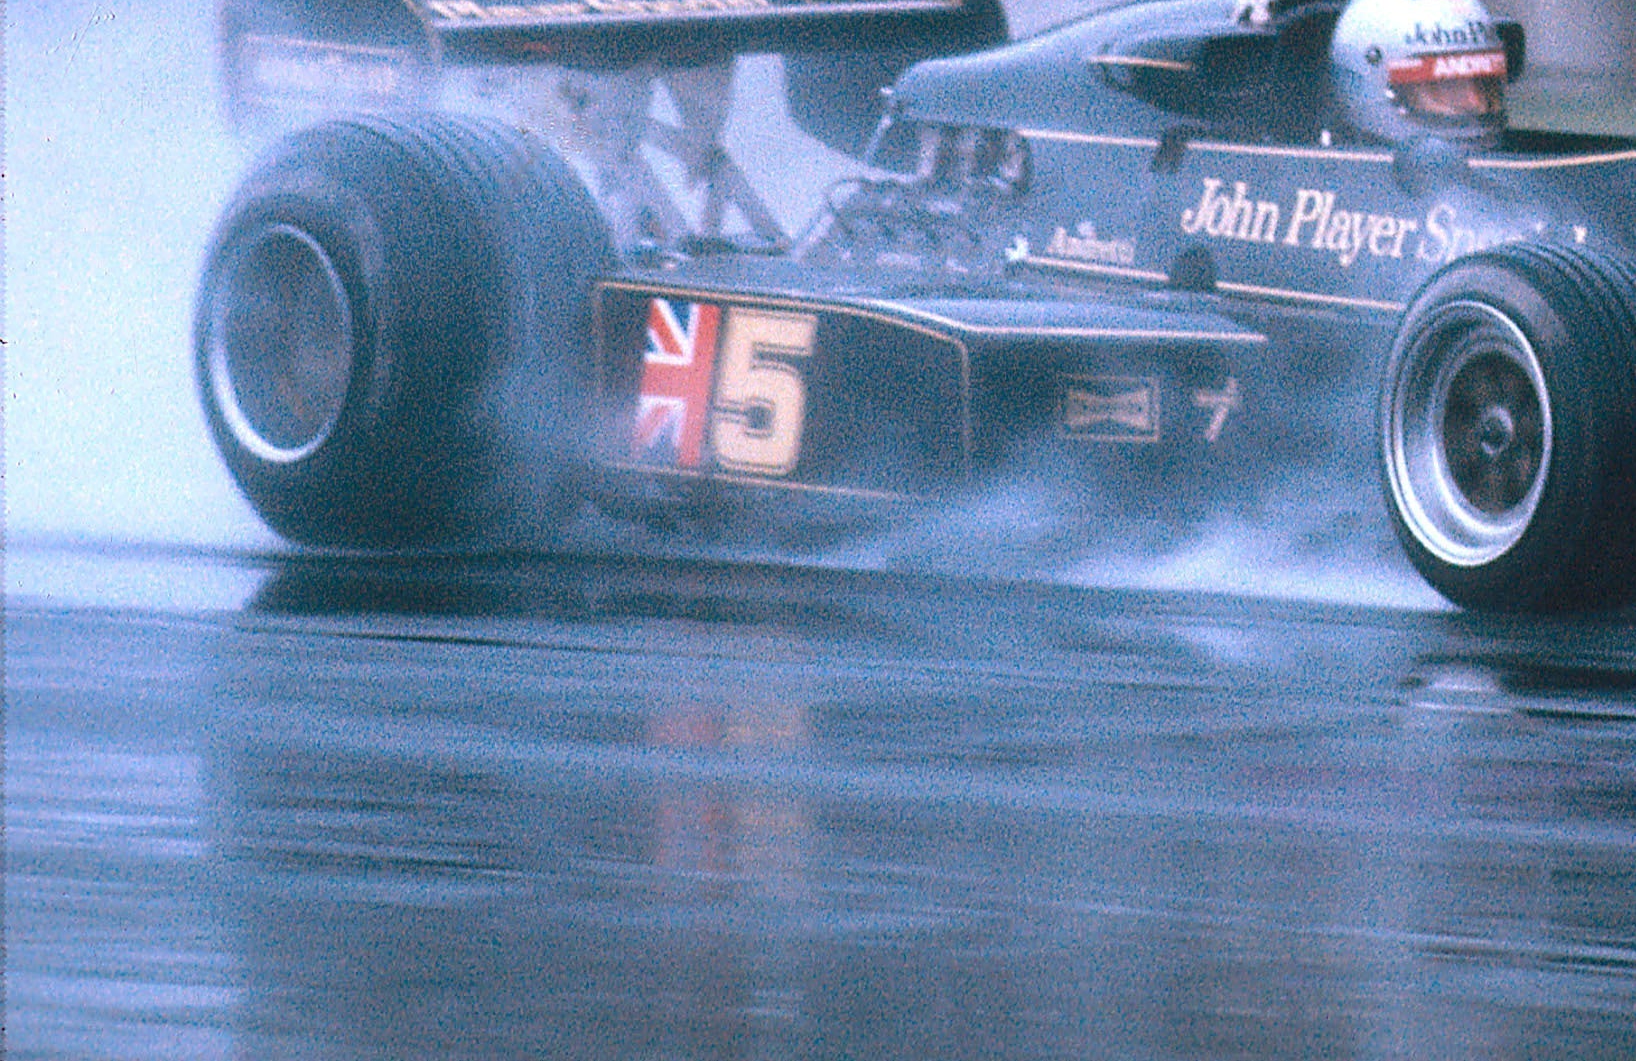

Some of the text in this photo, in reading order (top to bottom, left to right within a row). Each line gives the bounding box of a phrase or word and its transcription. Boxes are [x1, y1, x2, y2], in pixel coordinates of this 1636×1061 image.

[1181, 177, 1280, 241] John
[1286, 188, 1418, 267] Player
[712, 306, 818, 476] 5
